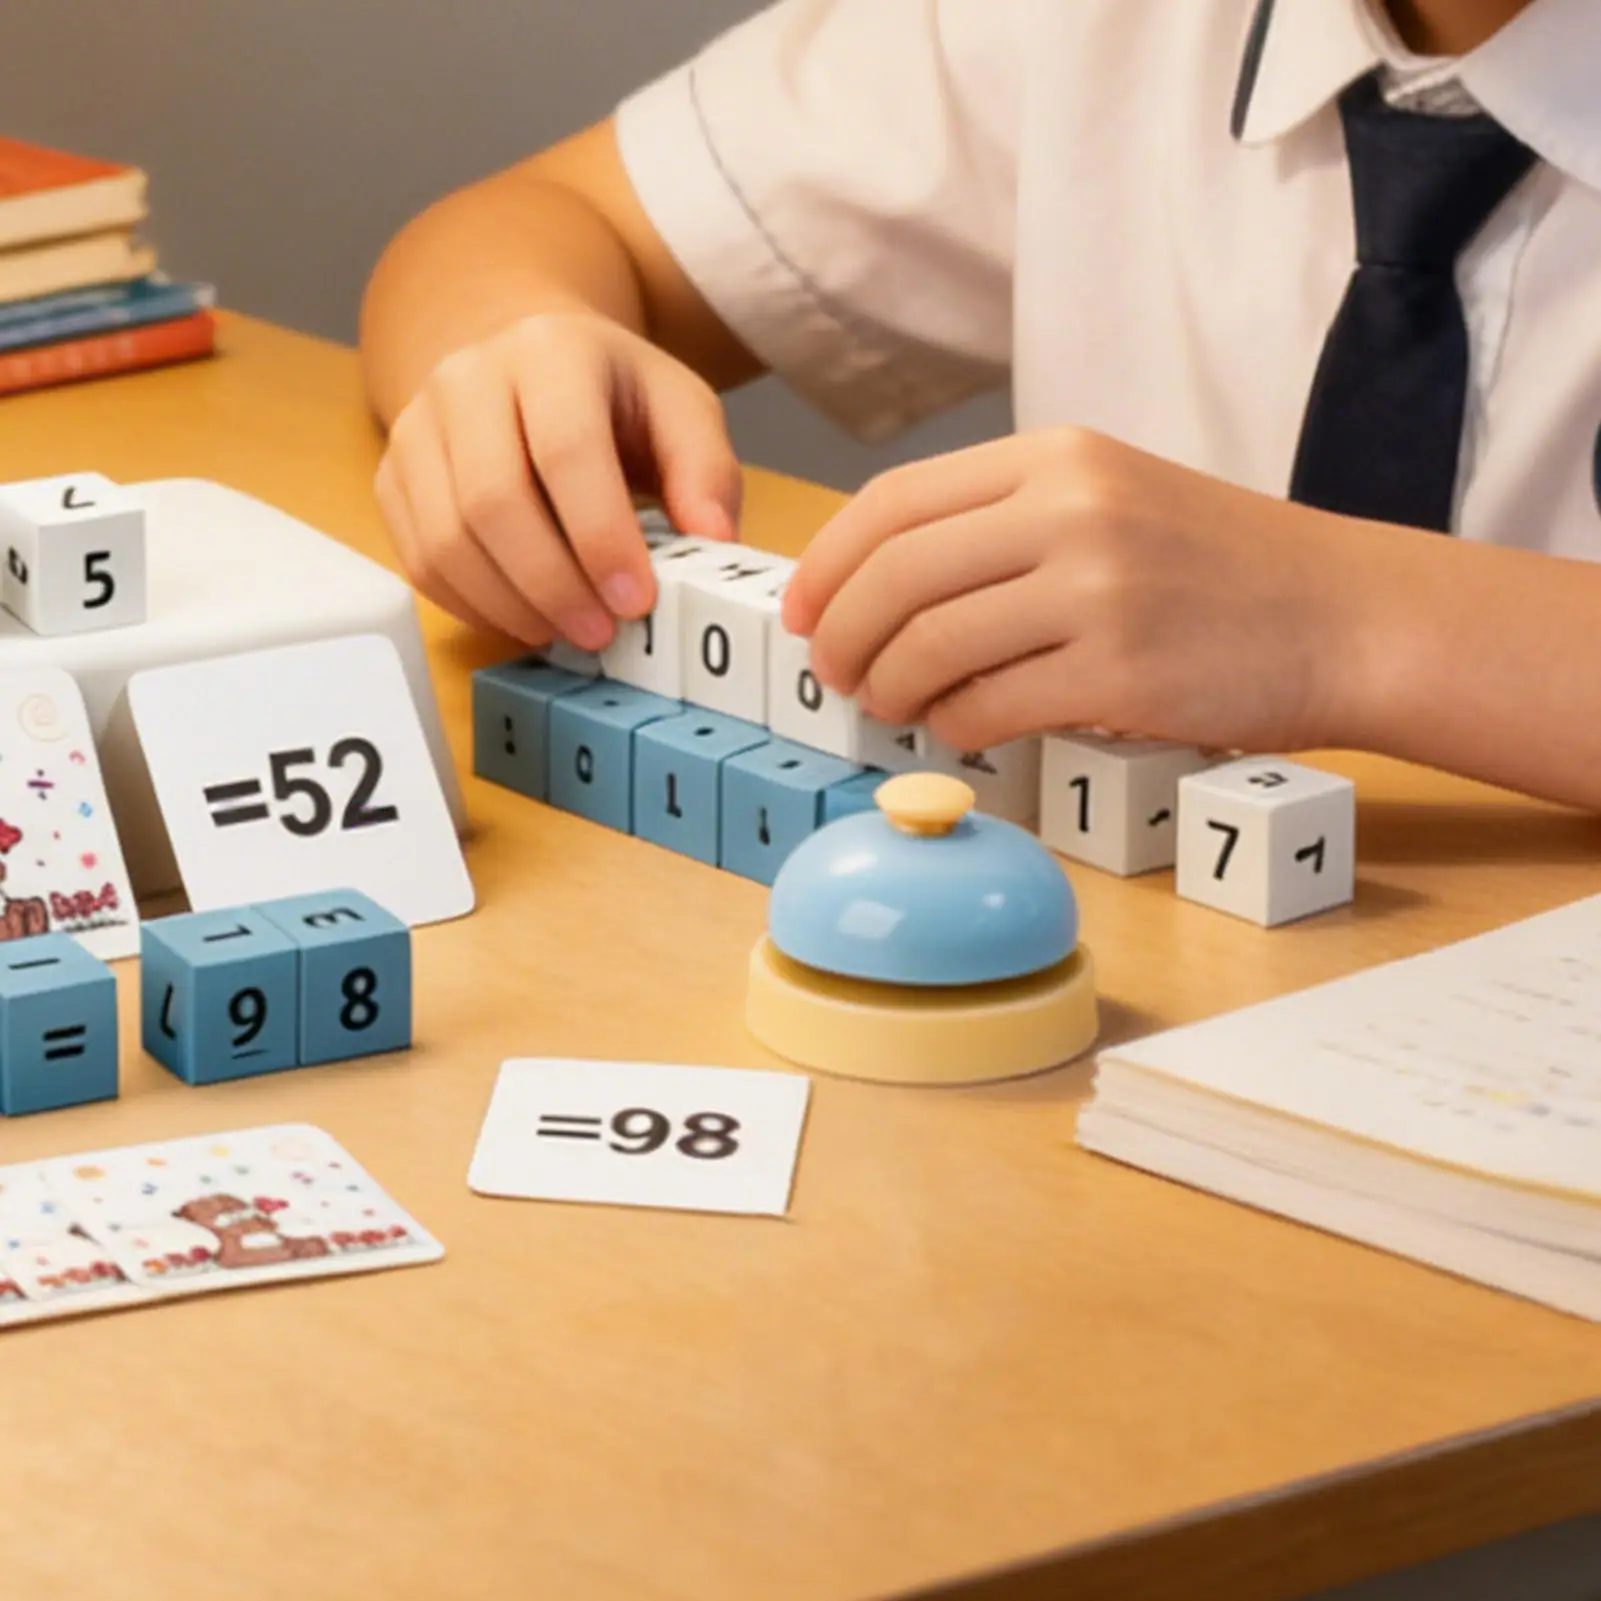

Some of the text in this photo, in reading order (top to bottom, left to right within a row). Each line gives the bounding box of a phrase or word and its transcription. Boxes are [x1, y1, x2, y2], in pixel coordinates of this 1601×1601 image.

[83, 550, 116, 609] 5
[701, 622, 731, 679] 0
[202, 736, 399, 837] =52
[1069, 775, 1090, 833] 1
[1206, 815, 1240, 881] 7
[339, 965, 380, 1032] 8
[535, 1106, 741, 1160] =98
